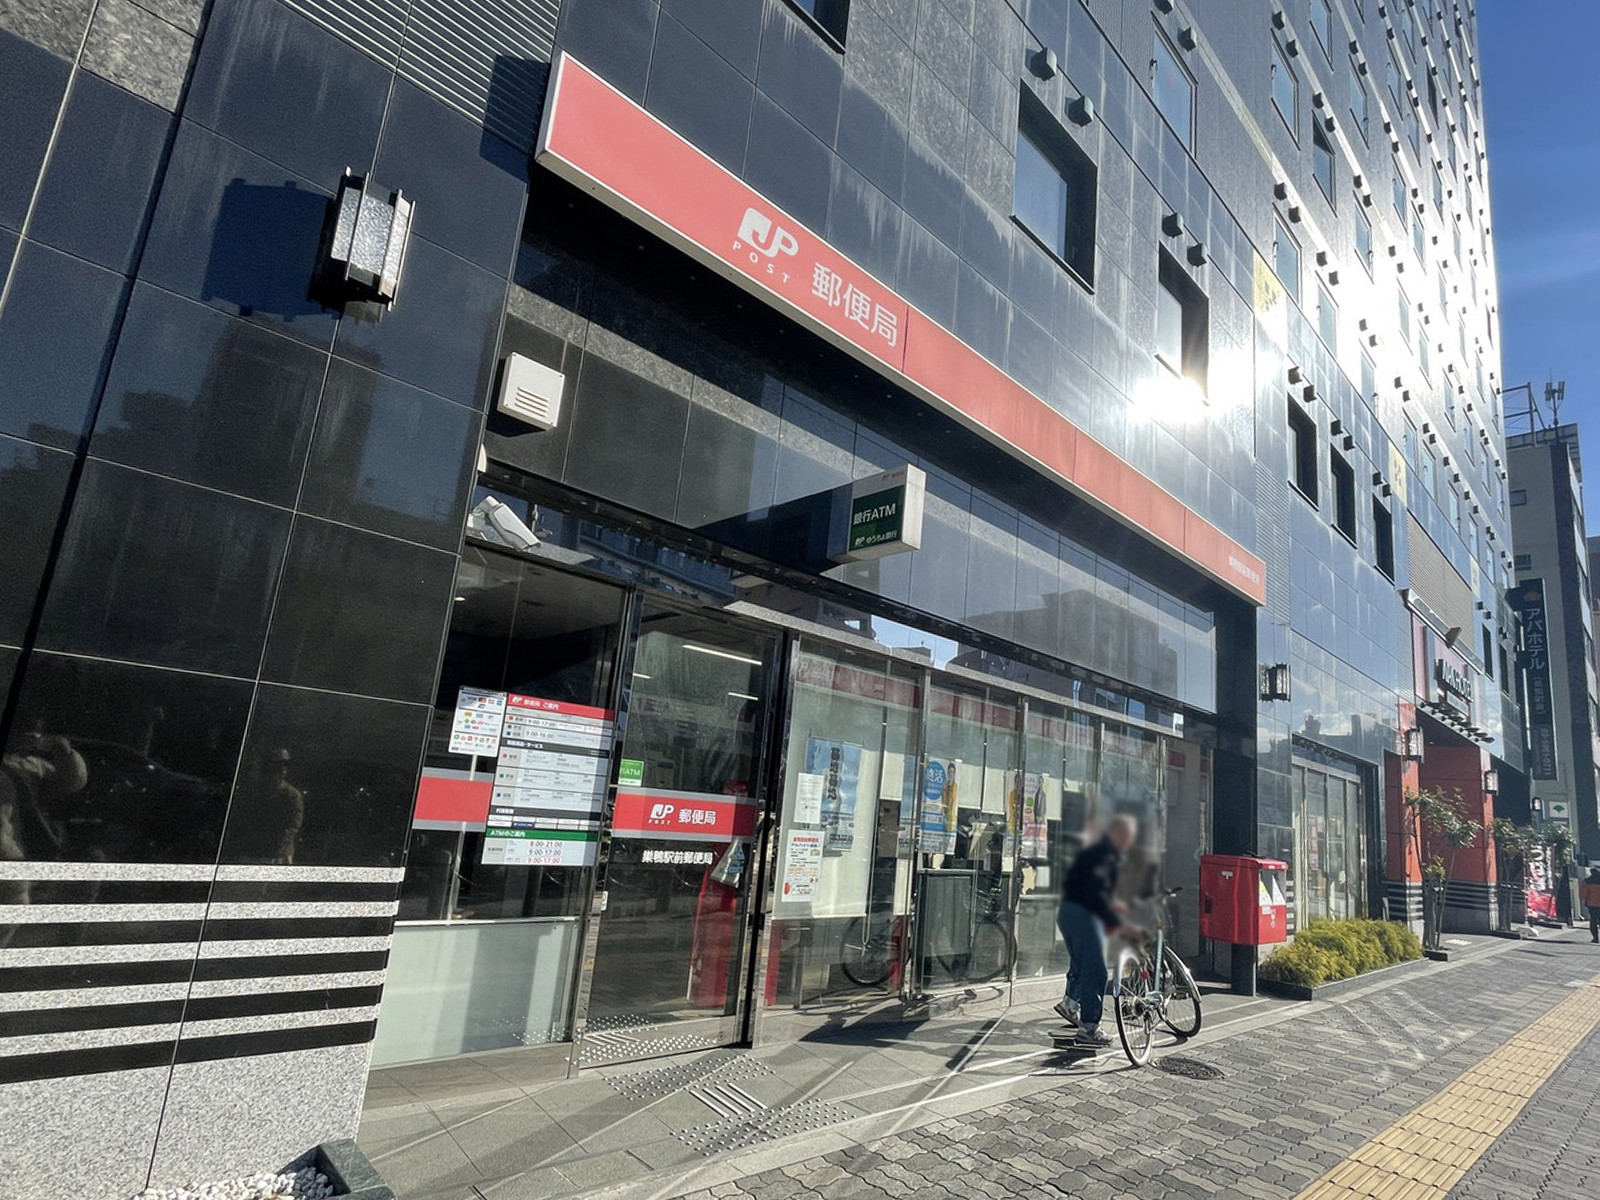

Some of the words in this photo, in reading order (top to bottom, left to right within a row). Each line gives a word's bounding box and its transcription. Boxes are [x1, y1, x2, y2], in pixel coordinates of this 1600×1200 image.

[732, 240, 791, 284] POST
[811, 261, 898, 347] 郵便局
[852, 503, 896, 526] 銀行ATM
[1525, 608, 1545, 670] アパホテル
[678, 808, 717, 826] 郵便局
[641, 849, 714, 865] 巣鴨駅前郵便局
